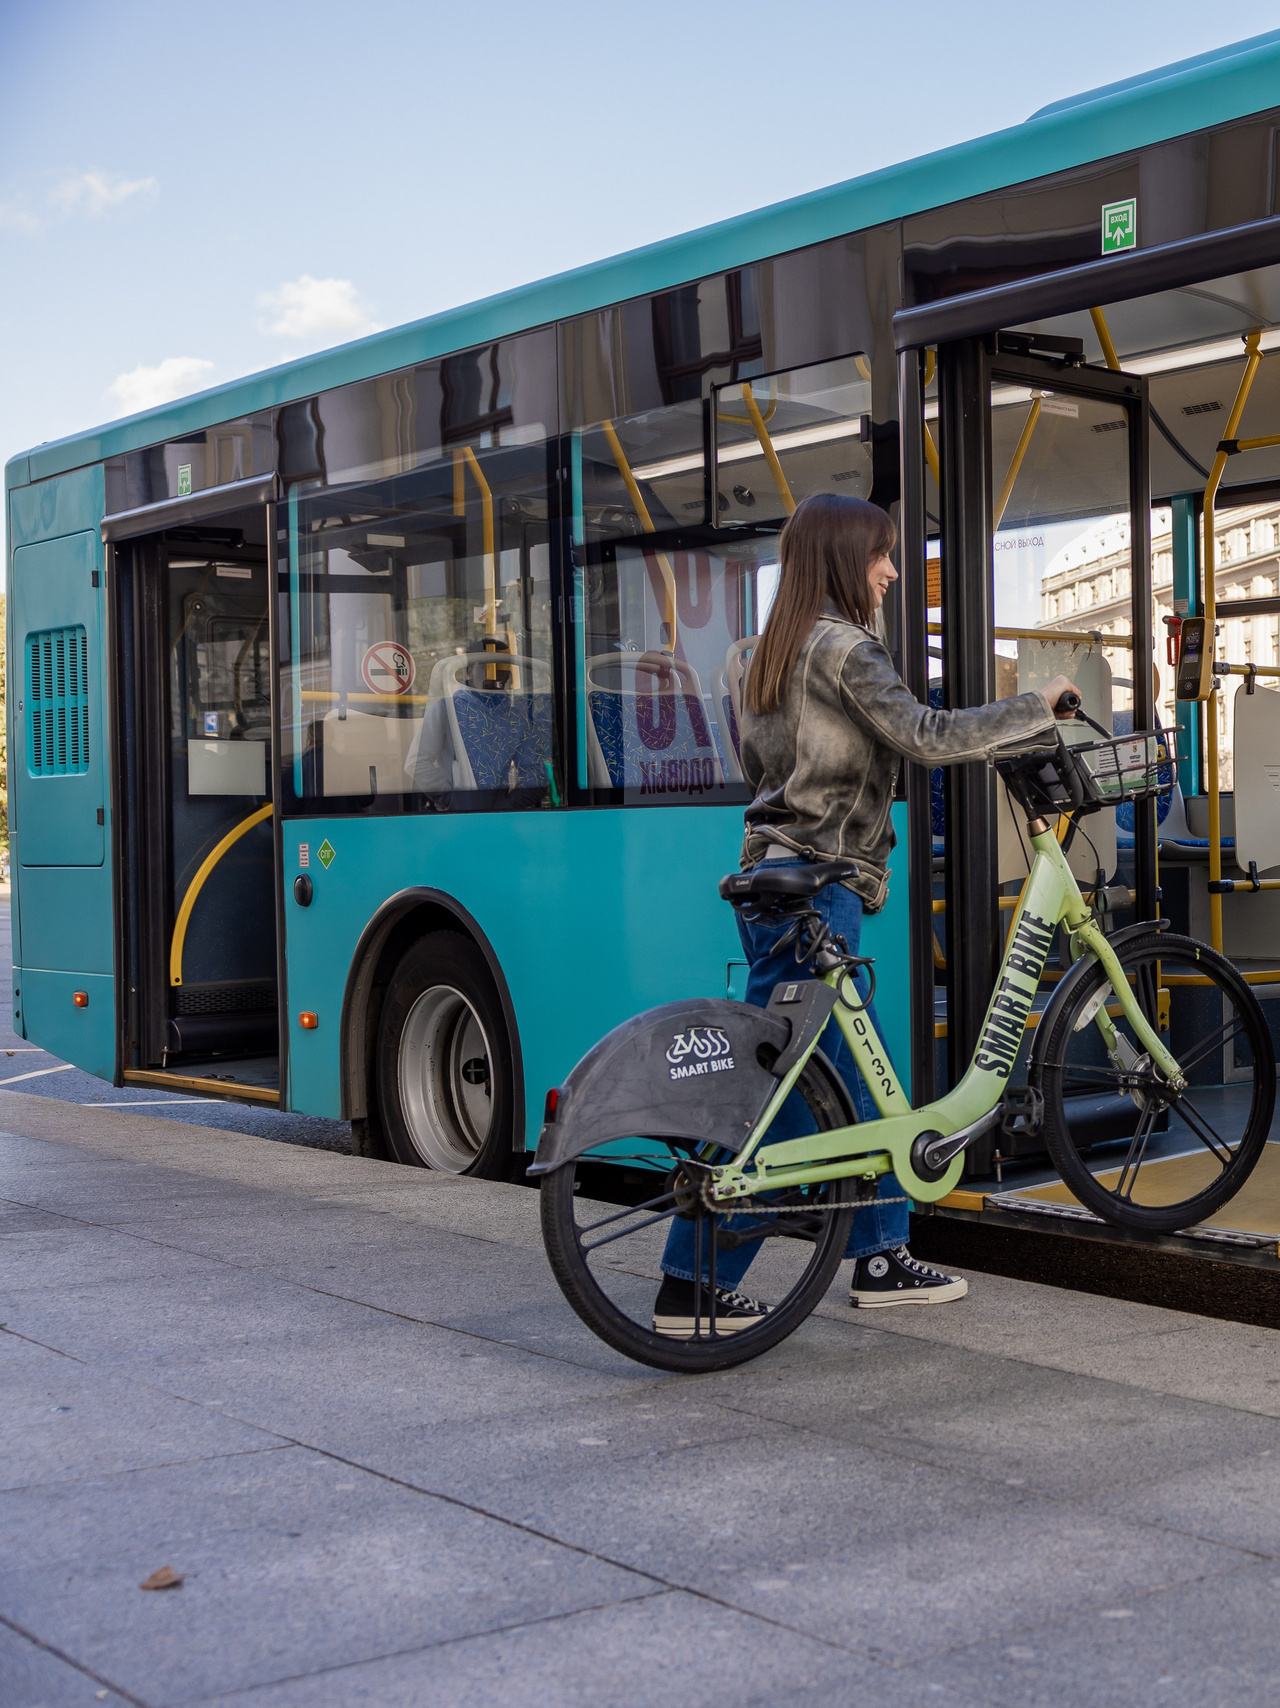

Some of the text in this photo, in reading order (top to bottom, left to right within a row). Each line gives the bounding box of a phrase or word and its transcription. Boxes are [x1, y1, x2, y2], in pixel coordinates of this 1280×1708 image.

[1111, 213, 1127, 223] ВХОД
[1018, 536, 1044, 548] ВЫХОД
[320, 849, 331, 859] СПГ
[974, 909, 1056, 1079] SMART BIKE
[853, 1017, 896, 1097] 0132
[670, 1057, 735, 1080] SMART BIKE
